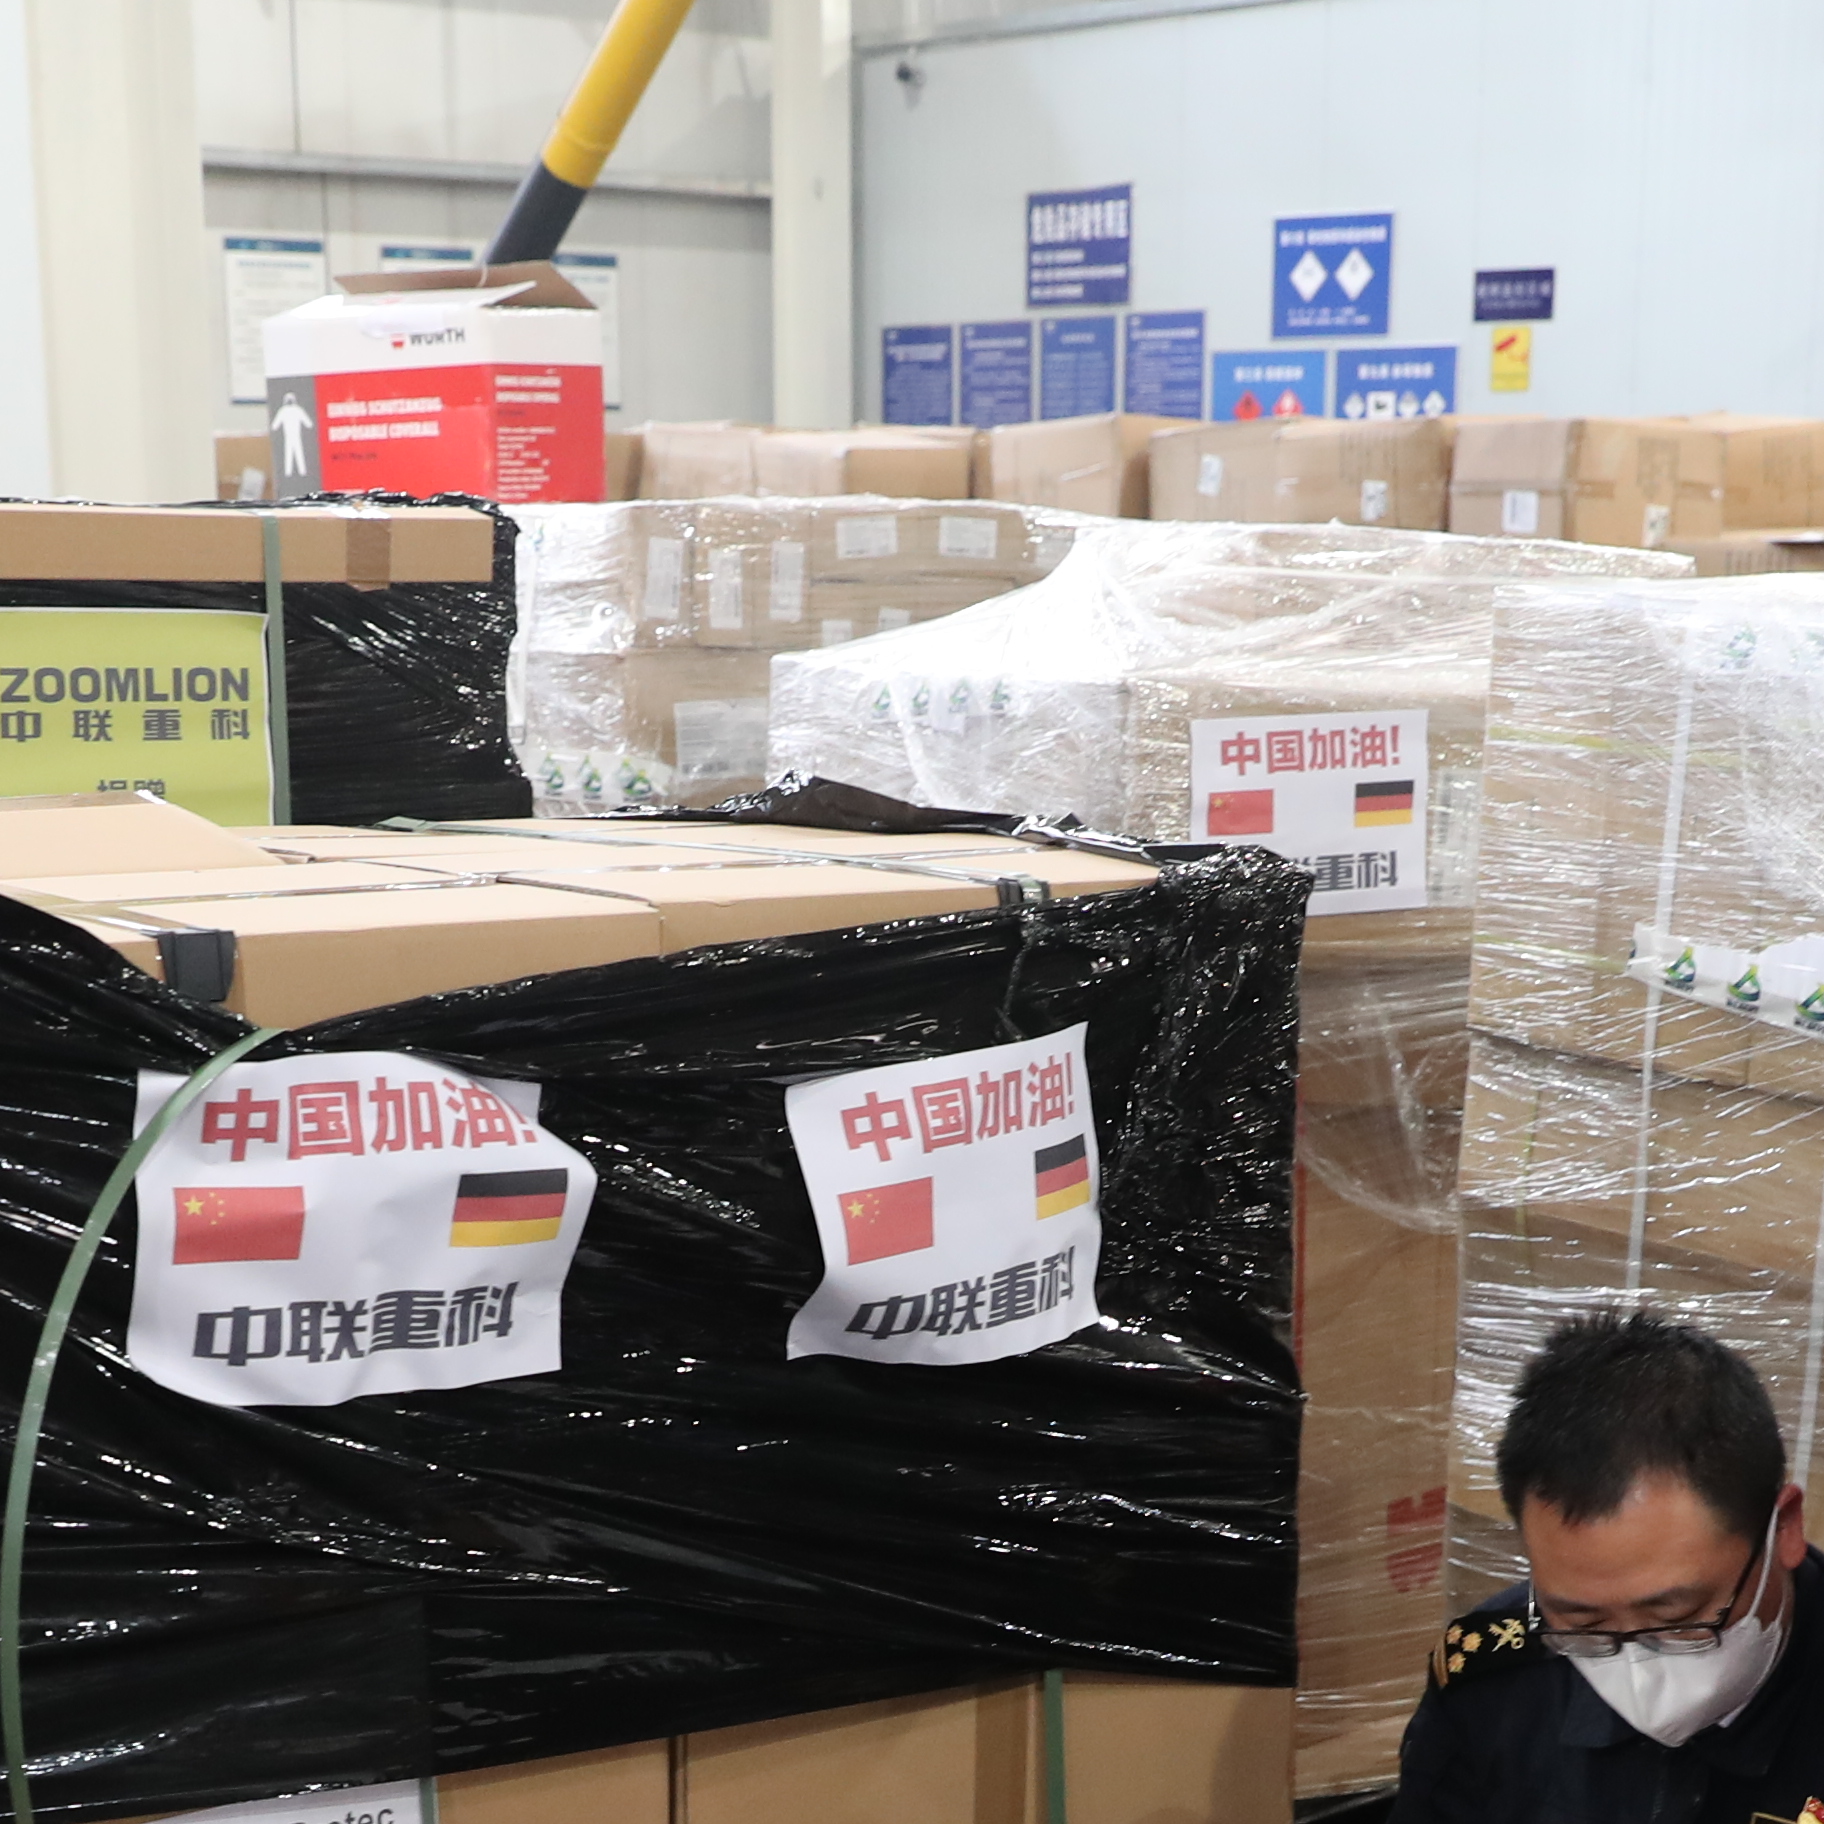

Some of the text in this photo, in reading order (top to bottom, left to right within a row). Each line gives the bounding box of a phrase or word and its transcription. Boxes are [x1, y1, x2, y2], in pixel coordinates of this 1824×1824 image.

[0, 708, 250, 742] 中联重科
[1220, 724, 1401, 776] 中国加油!
[200, 1076, 538, 1162] 中国加油!
[840, 1051, 1075, 1162] 中国加油!
[192, 1281, 519, 1366] 中联重科
[844, 1245, 1075, 1340] 中联重科
